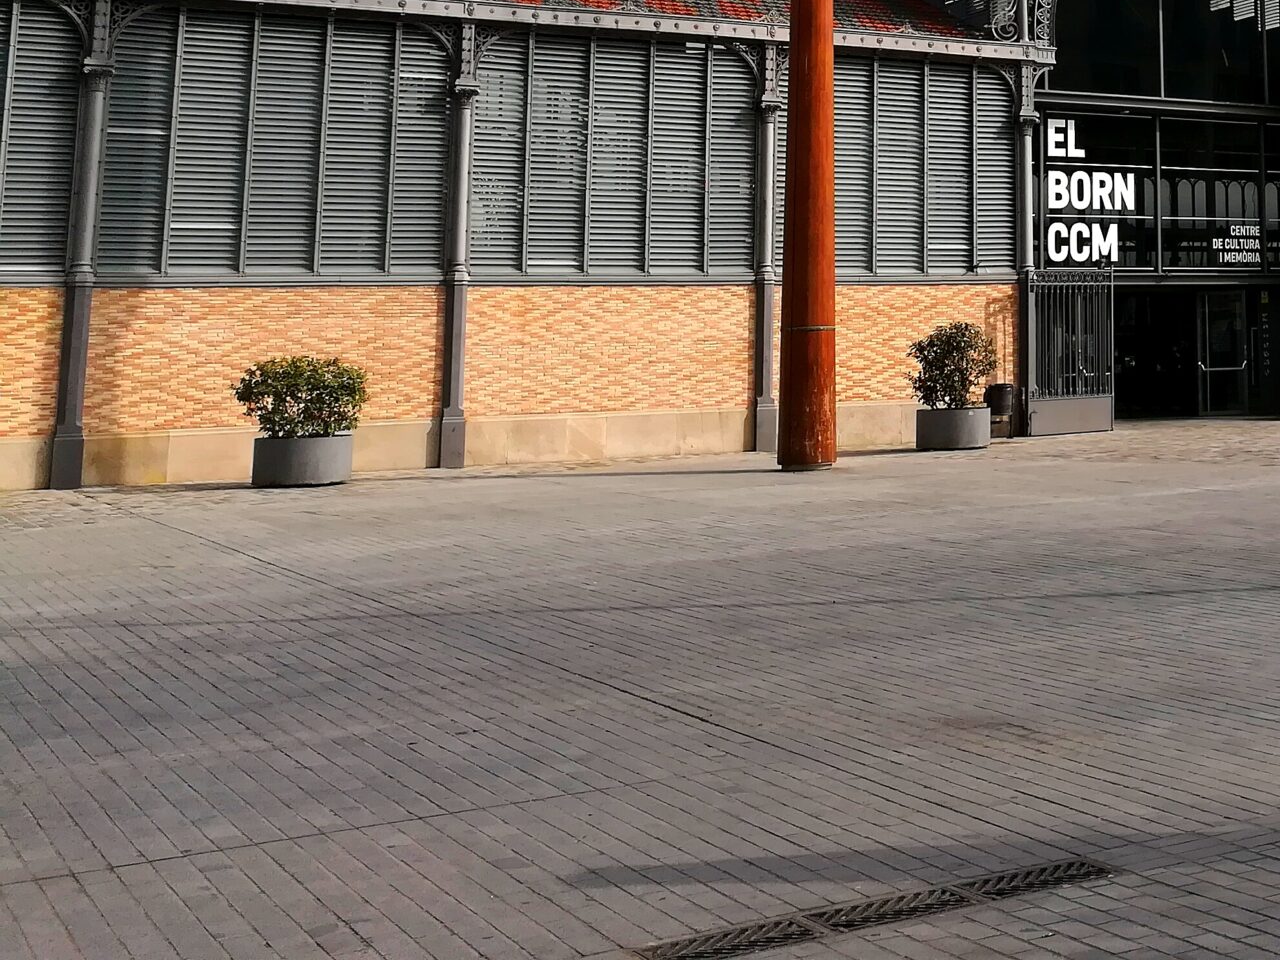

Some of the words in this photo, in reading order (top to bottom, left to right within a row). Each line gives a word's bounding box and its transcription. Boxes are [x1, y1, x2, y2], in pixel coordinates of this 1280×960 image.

[1047, 119, 1085, 158] EL
[1047, 170, 1135, 211] BORN
[1047, 222, 1119, 262] CCM
[1230, 225, 1261, 236] CENTRE
[1212, 238, 1223, 249] DE
[1224, 238, 1261, 250] CULTURA
[1224, 250, 1261, 263] MEMÒRIA
